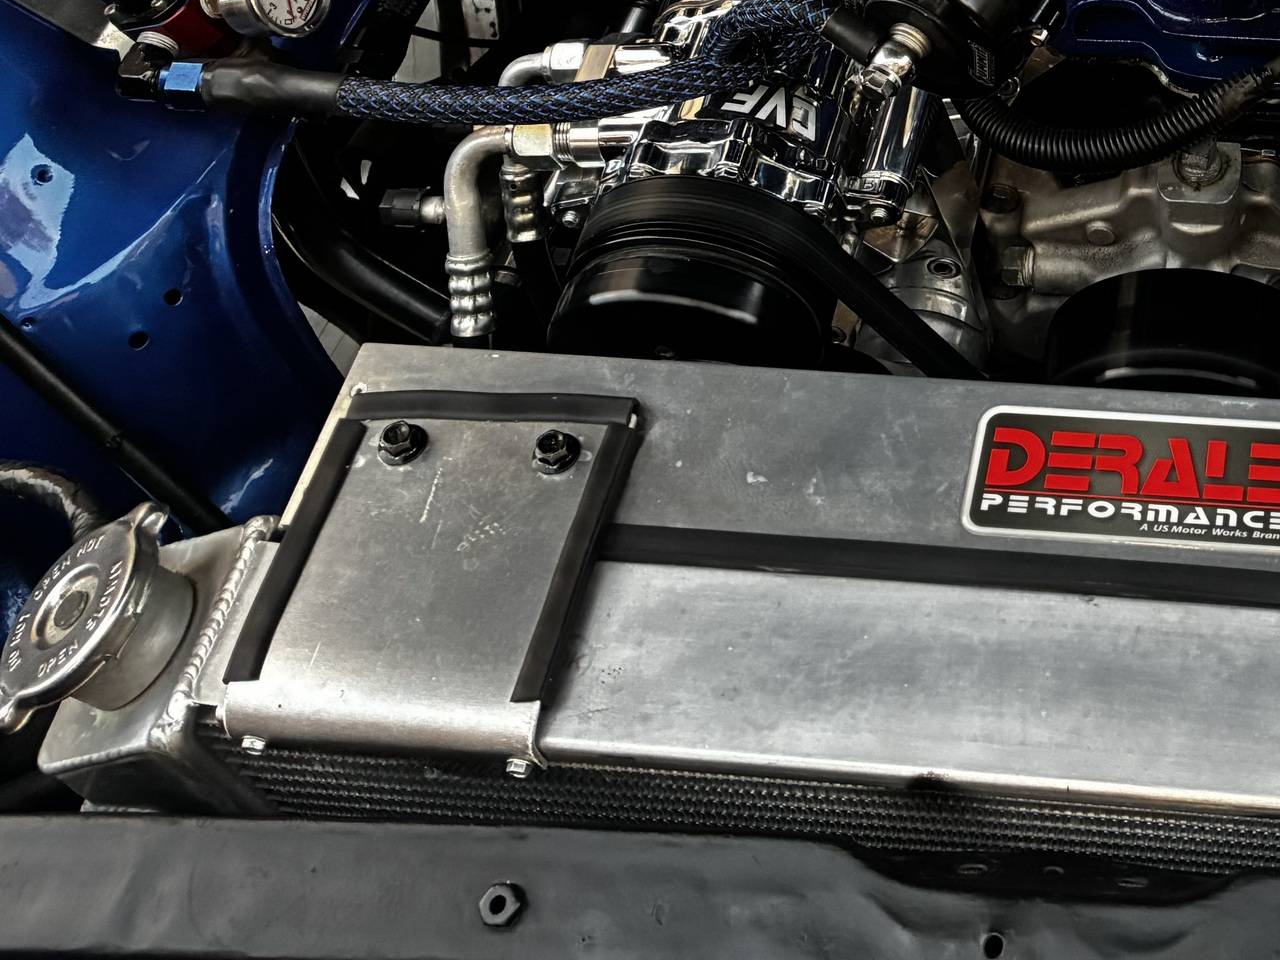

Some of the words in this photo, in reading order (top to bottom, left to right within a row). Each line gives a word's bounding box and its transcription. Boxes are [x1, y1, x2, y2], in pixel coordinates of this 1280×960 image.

[720, 83, 817, 143] CVF
[1139, 523, 1149, 532] A
[1153, 524, 1169, 533] US
[1171, 525, 1208, 535] Motor
[1212, 527, 1248, 538] Works
[33, 556, 73, 602] OPEN
[37, 639, 80, 679] OPEN
